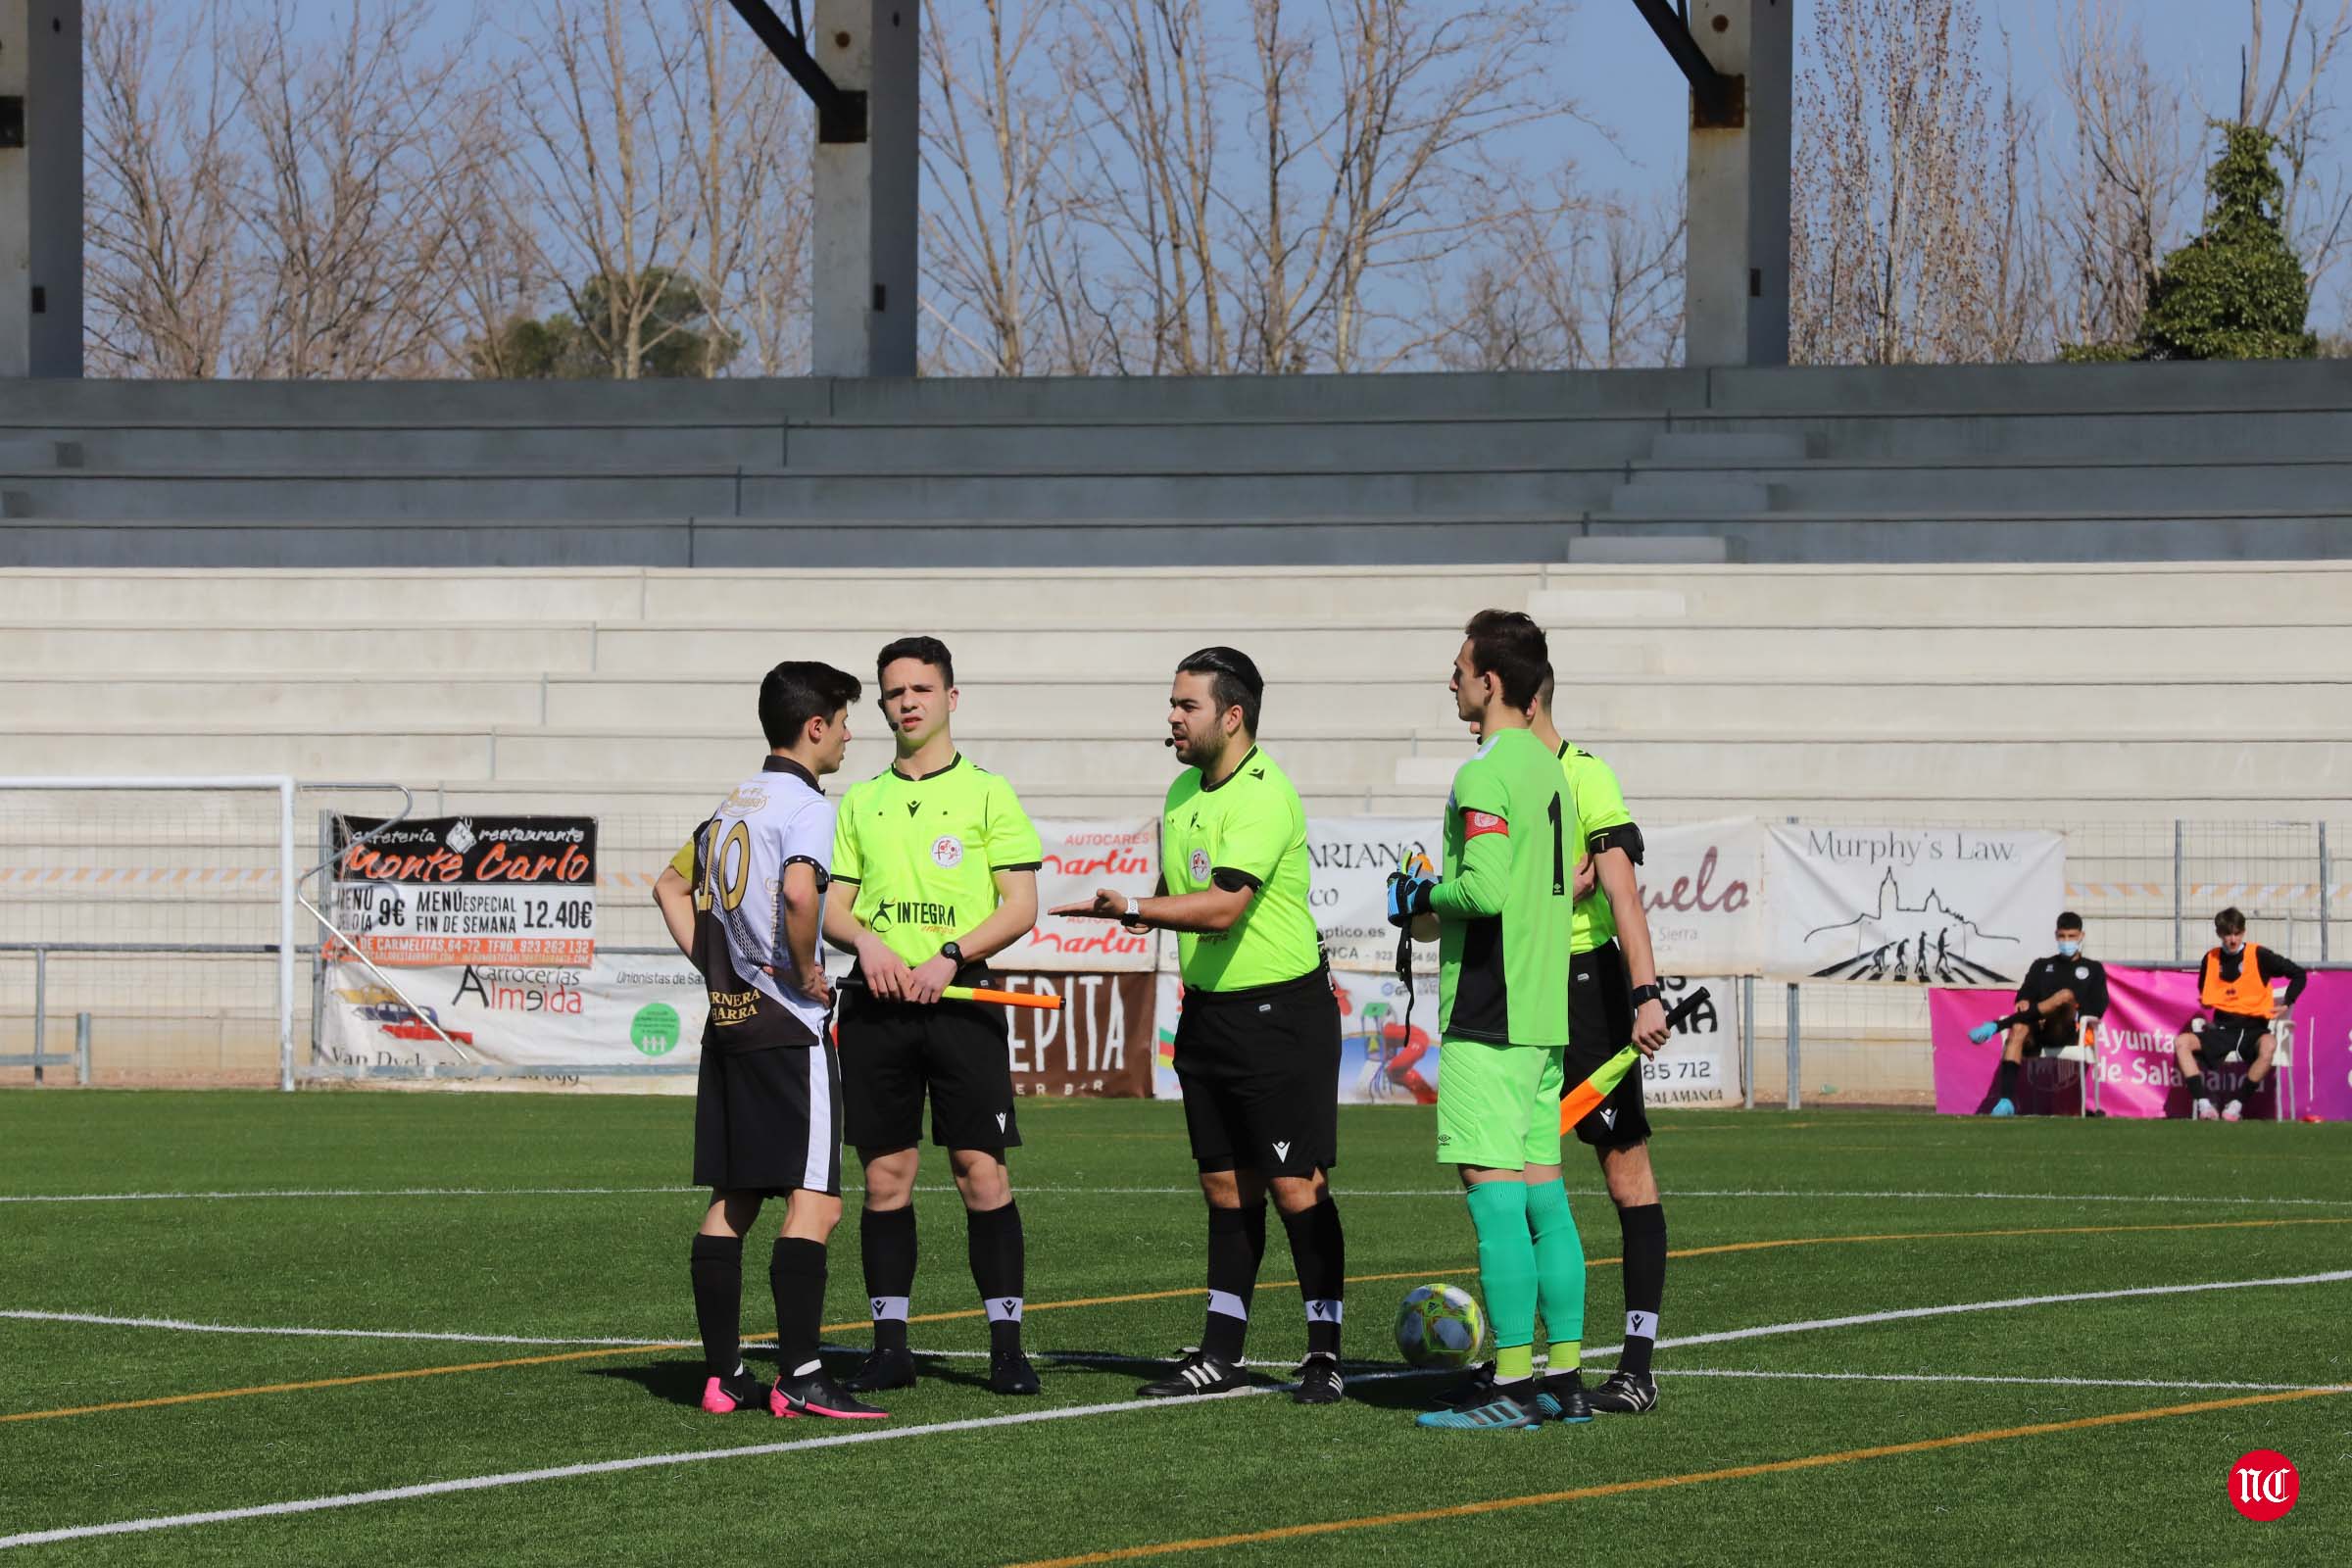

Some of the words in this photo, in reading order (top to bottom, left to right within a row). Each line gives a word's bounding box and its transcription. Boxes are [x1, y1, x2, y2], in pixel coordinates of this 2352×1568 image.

[478, 826, 584, 843] restaurante
[1064, 832, 1150, 847] AUTOCARES
[1547, 790, 1564, 896] 1
[1808, 830, 1943, 866] Murphy's
[1957, 832, 2015, 860] Law
[339, 844, 464, 882] Monte
[475, 842, 590, 882] Carlo
[698, 819, 751, 911] 10
[378, 898, 406, 927] 9€
[416, 915, 438, 933] FIN
[443, 915, 459, 934] DE
[463, 915, 517, 934] SEMANA
[523, 900, 593, 929] 12.40€
[897, 901, 956, 928] INTEGRA
[451, 964, 583, 1015] Almeida
[616, 971, 672, 986] Unionistas
[672, 971, 686, 985] de
[710, 989, 761, 1007] RNERA
[1678, 1061, 1711, 1078] 712
